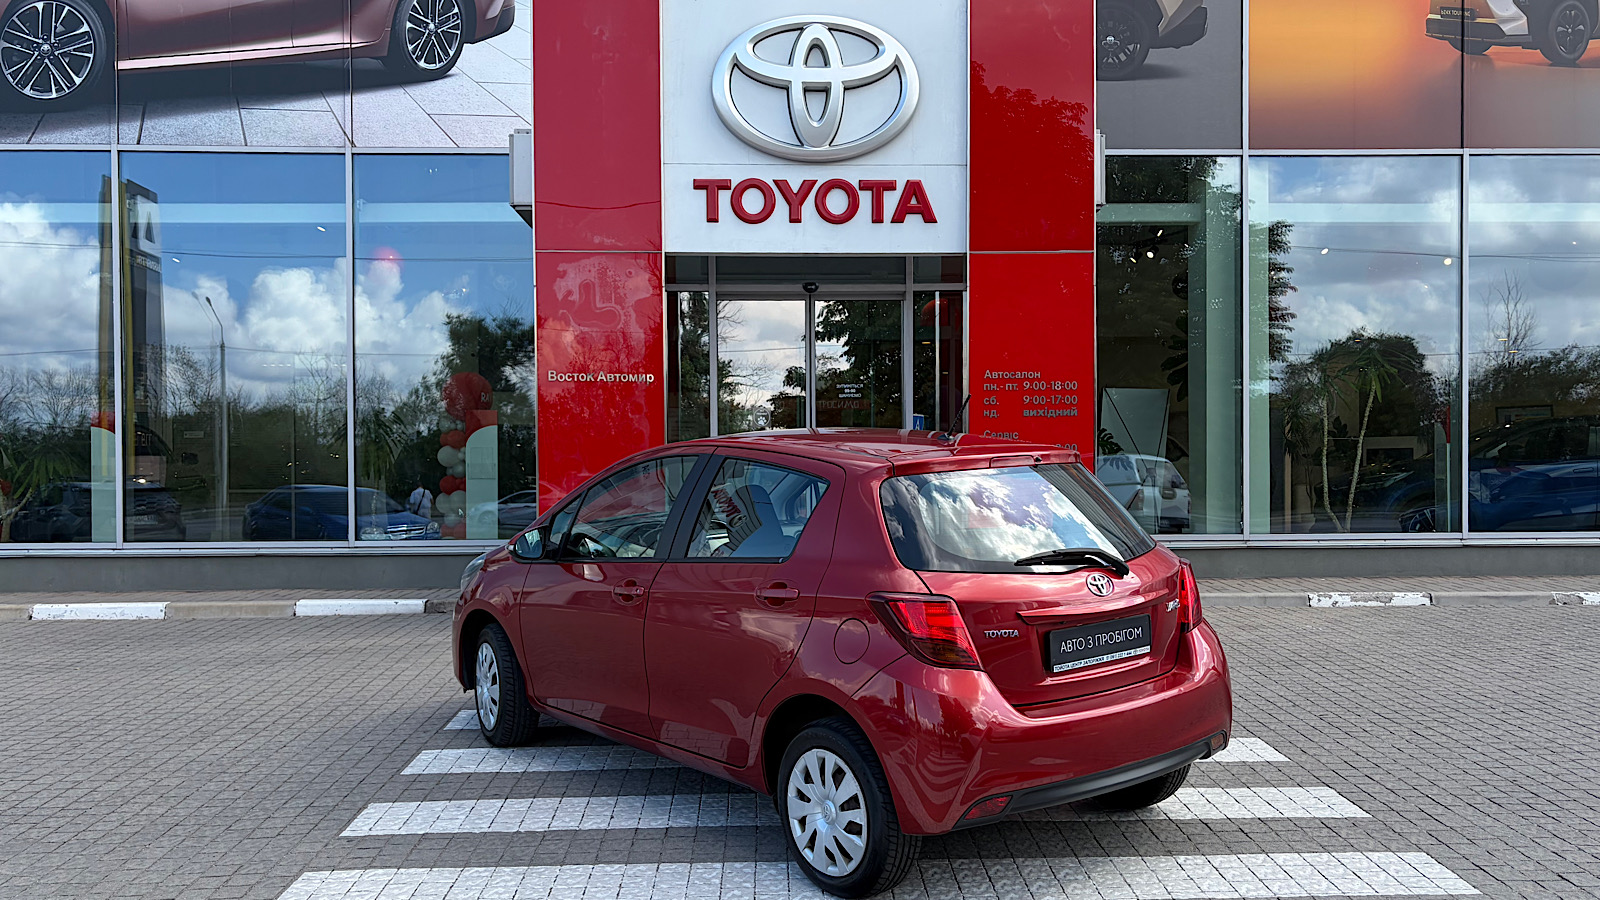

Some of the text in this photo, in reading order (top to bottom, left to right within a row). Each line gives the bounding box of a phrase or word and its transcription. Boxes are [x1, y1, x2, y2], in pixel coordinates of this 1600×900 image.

[692, 177, 938, 225] TOYOTA
[548, 370, 655, 386] Восток Автомир
[984, 370, 1041, 379] Автосалон
[1023, 381, 1078, 391] 9:00-18:00
[984, 395, 1078, 405] сб. 9:00-17:00
[984, 407, 1078, 418] нд. вихідний
[984, 629, 1020, 639] TOYOTA
[1060, 637, 1086, 654] АВТО
[1095, 626, 1143, 647] ПРОБІГОМ
